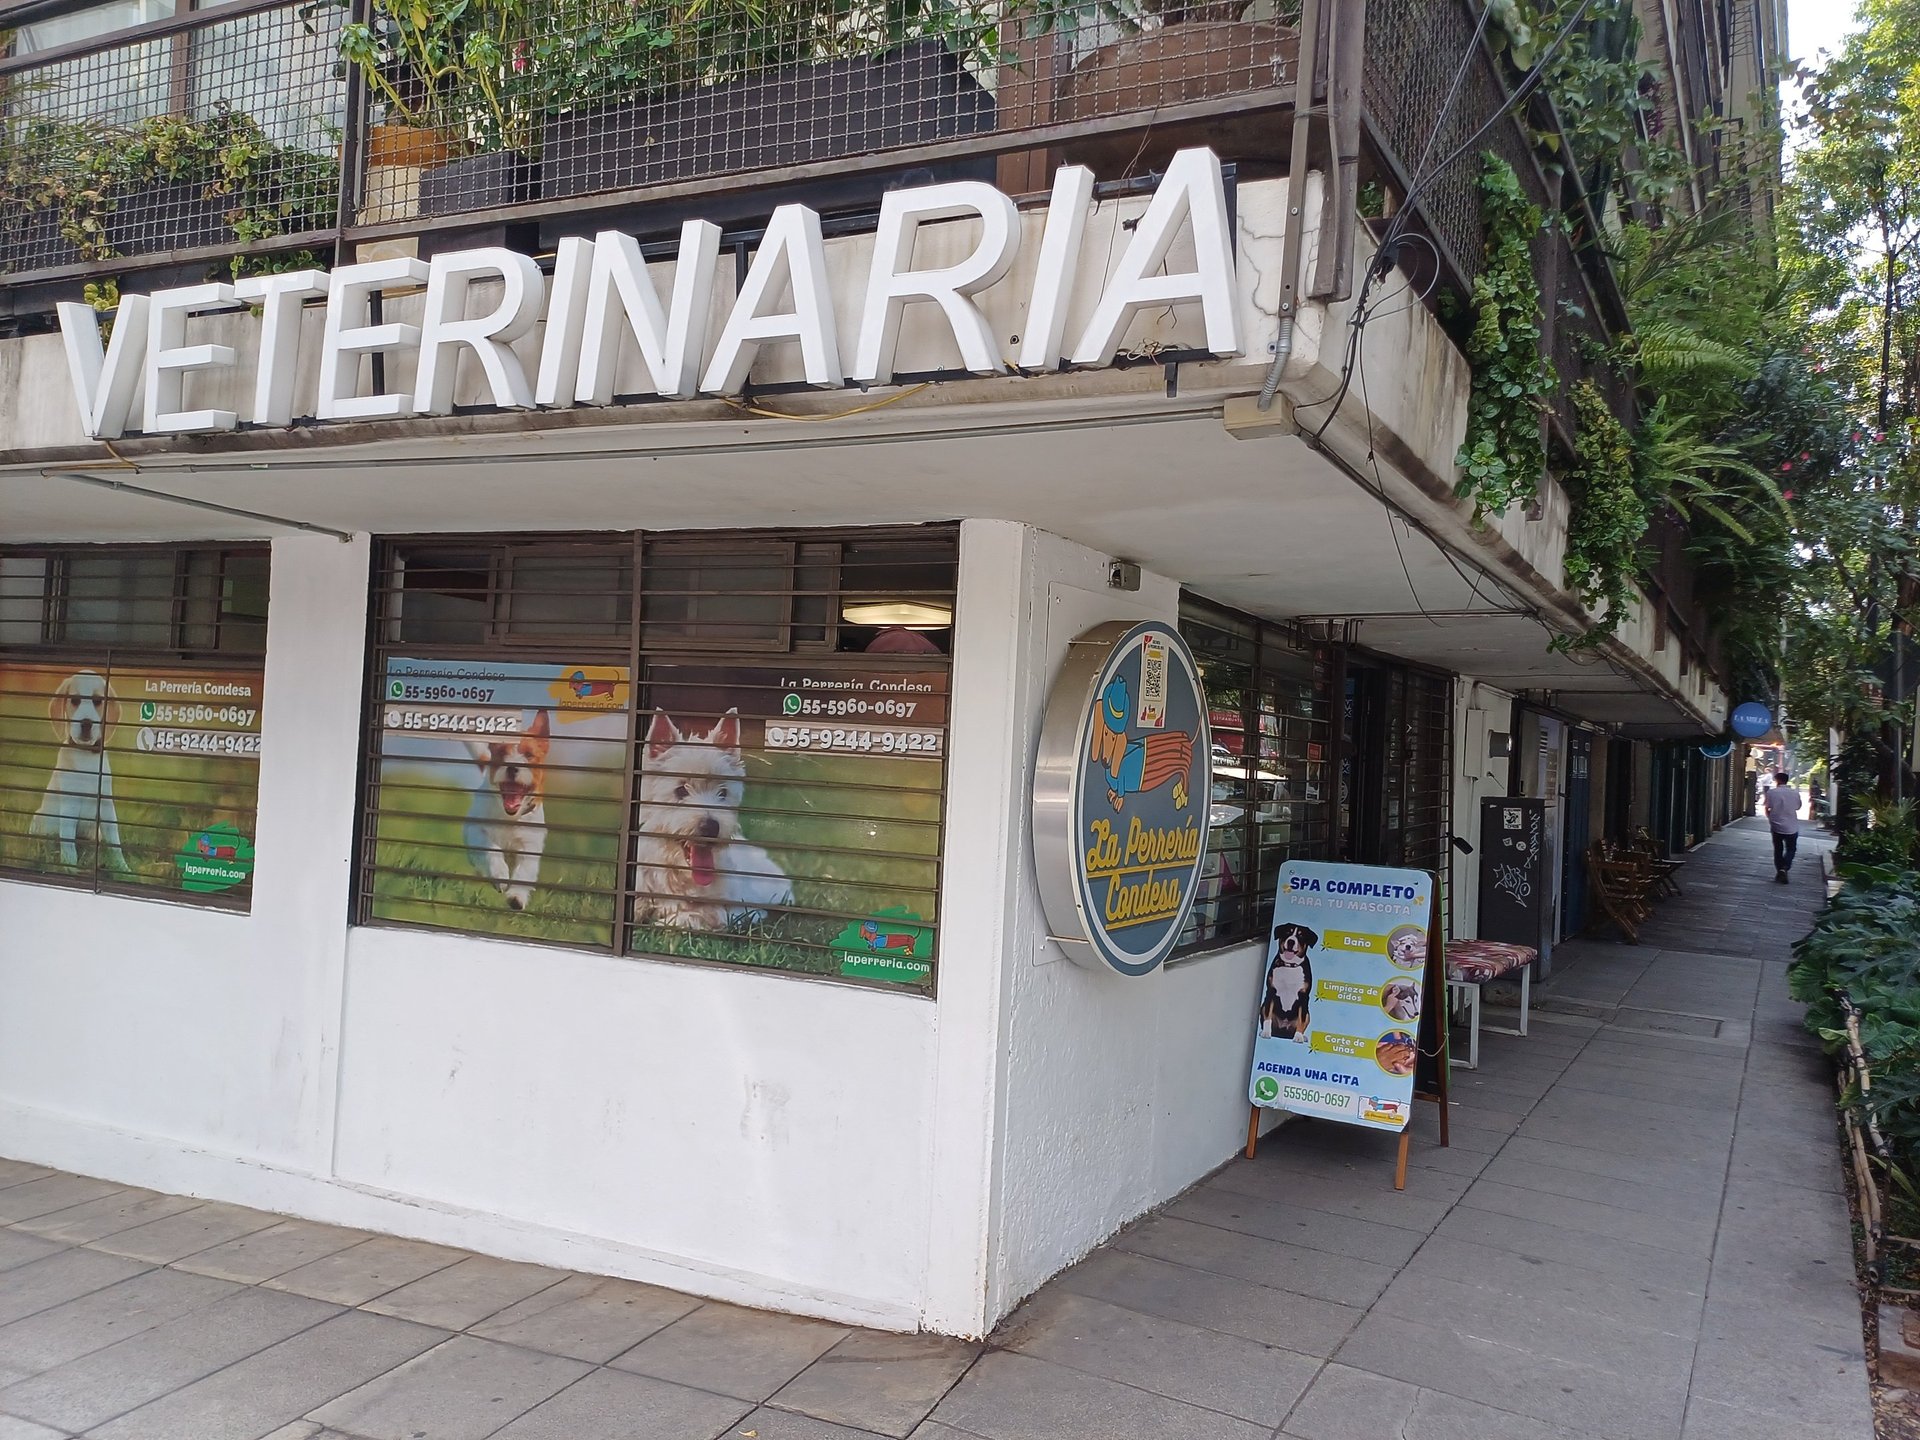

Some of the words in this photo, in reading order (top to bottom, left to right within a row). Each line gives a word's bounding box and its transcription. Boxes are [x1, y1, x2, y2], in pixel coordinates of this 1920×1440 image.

[57, 147, 1244, 440] VETERINARIA
[145, 680, 158, 693] La
[159, 680, 202, 694] Perrería
[204, 682, 252, 697] Condesa
[404, 684, 495, 703] 55-5960-0697
[780, 677, 797, 688] La
[869, 678, 932, 693] Condesa
[156, 704, 256, 727] 55-5960-0697
[802, 697, 917, 718] 55-5960-0697
[403, 711, 517, 733] 55-9244-9422
[156, 731, 261, 754] 55-9244-9422
[786, 727, 937, 753] 55-9244-9422
[1086, 818, 1122, 872] La
[1124, 814, 1200, 866] Perrería
[185, 862, 246, 879] laperreria.com
[1105, 869, 1181, 922] Condesa
[1290, 876, 1321, 892] SPA
[1326, 880, 1415, 900] COMPLETO
[1290, 895, 1322, 908] PARA
[1327, 898, 1344, 909] TU
[1347, 900, 1411, 915] MASCOTA
[1343, 936, 1372, 948] Baño
[844, 951, 930, 973] laperreria.com
[1323, 982, 1364, 993] Limpieza
[1366, 987, 1378, 996] de
[1337, 992, 1362, 1002] oídos
[1324, 1034, 1351, 1046] Corte
[1353, 1038, 1365, 1048] de
[1332, 1044, 1355, 1055] uñas
[1257, 1062, 1301, 1077] AGENDA
[1304, 1069, 1328, 1082] UNA
[1331, 1073, 1360, 1087] CITA
[1283, 1085, 1351, 1108] 555960-0697
